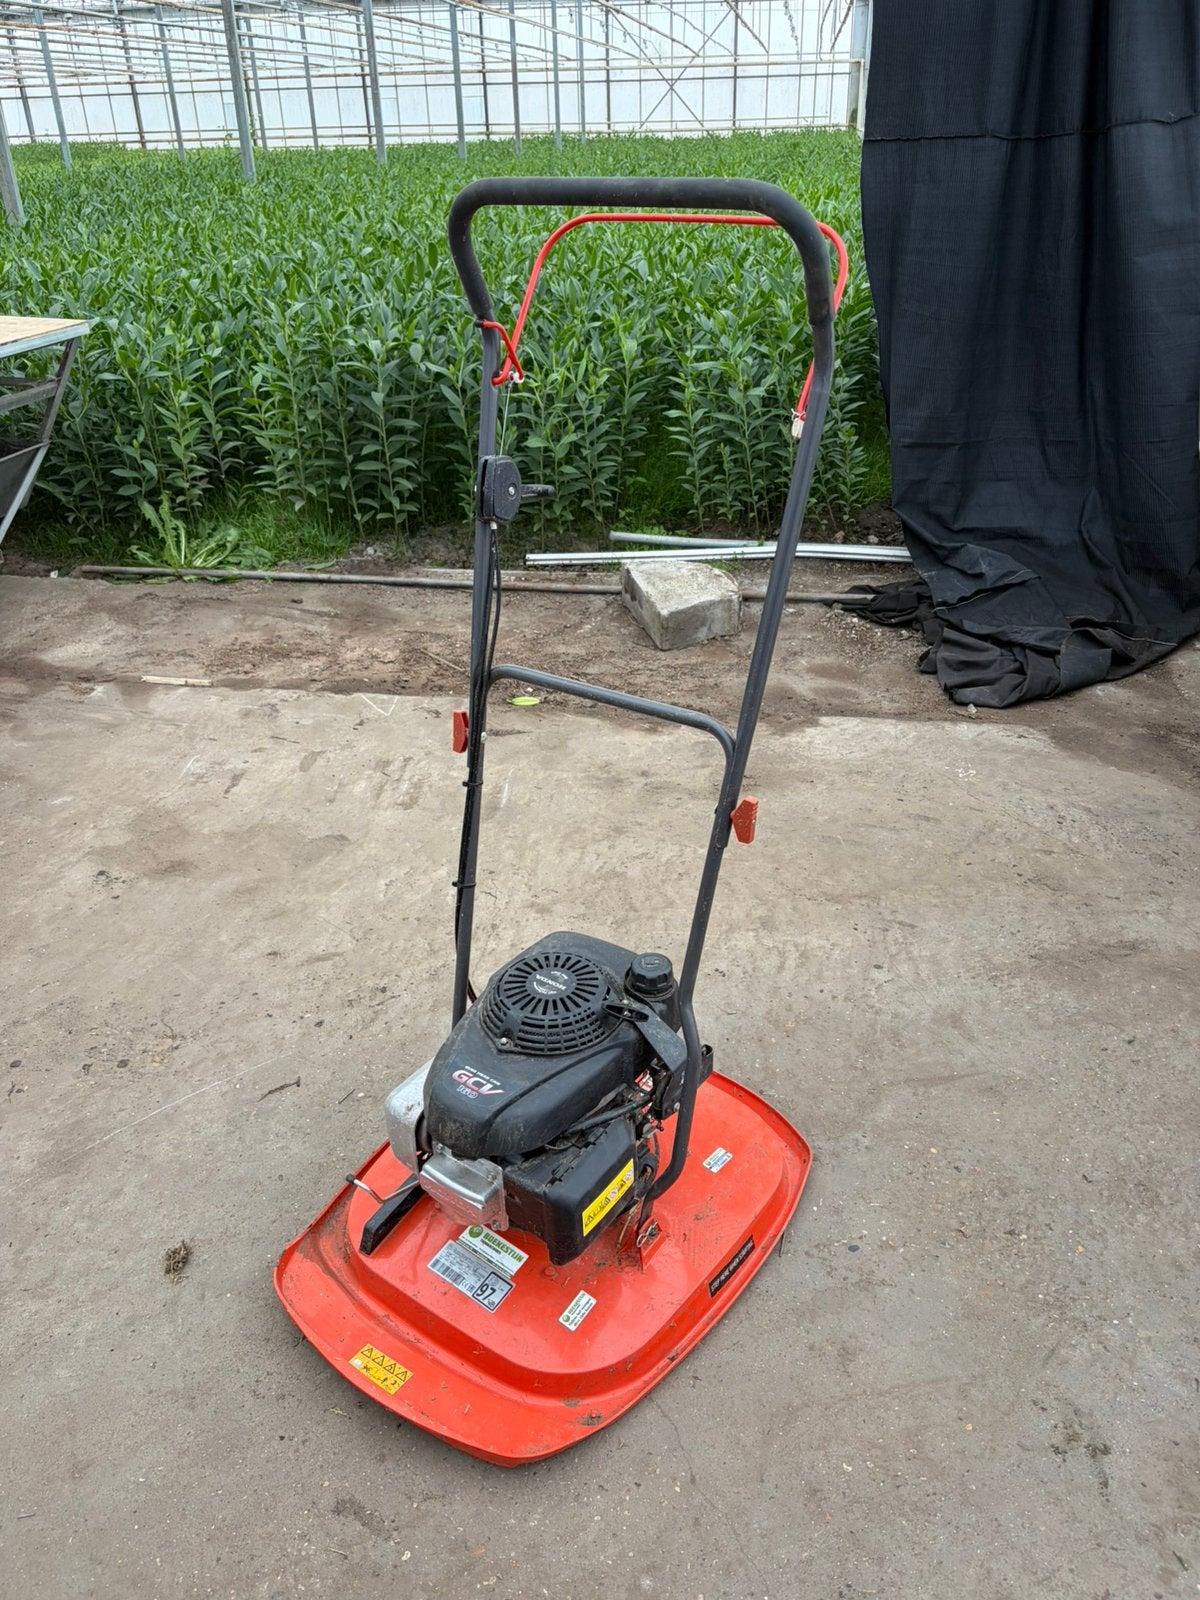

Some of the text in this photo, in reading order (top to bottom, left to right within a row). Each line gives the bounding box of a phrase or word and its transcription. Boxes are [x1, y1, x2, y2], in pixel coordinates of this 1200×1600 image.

[536, 974, 567, 991] HONDA
[452, 1069, 505, 1096] GCV
[482, 1232, 524, 1263] BOEKESTIJN
[475, 1283, 497, 1301] 97
